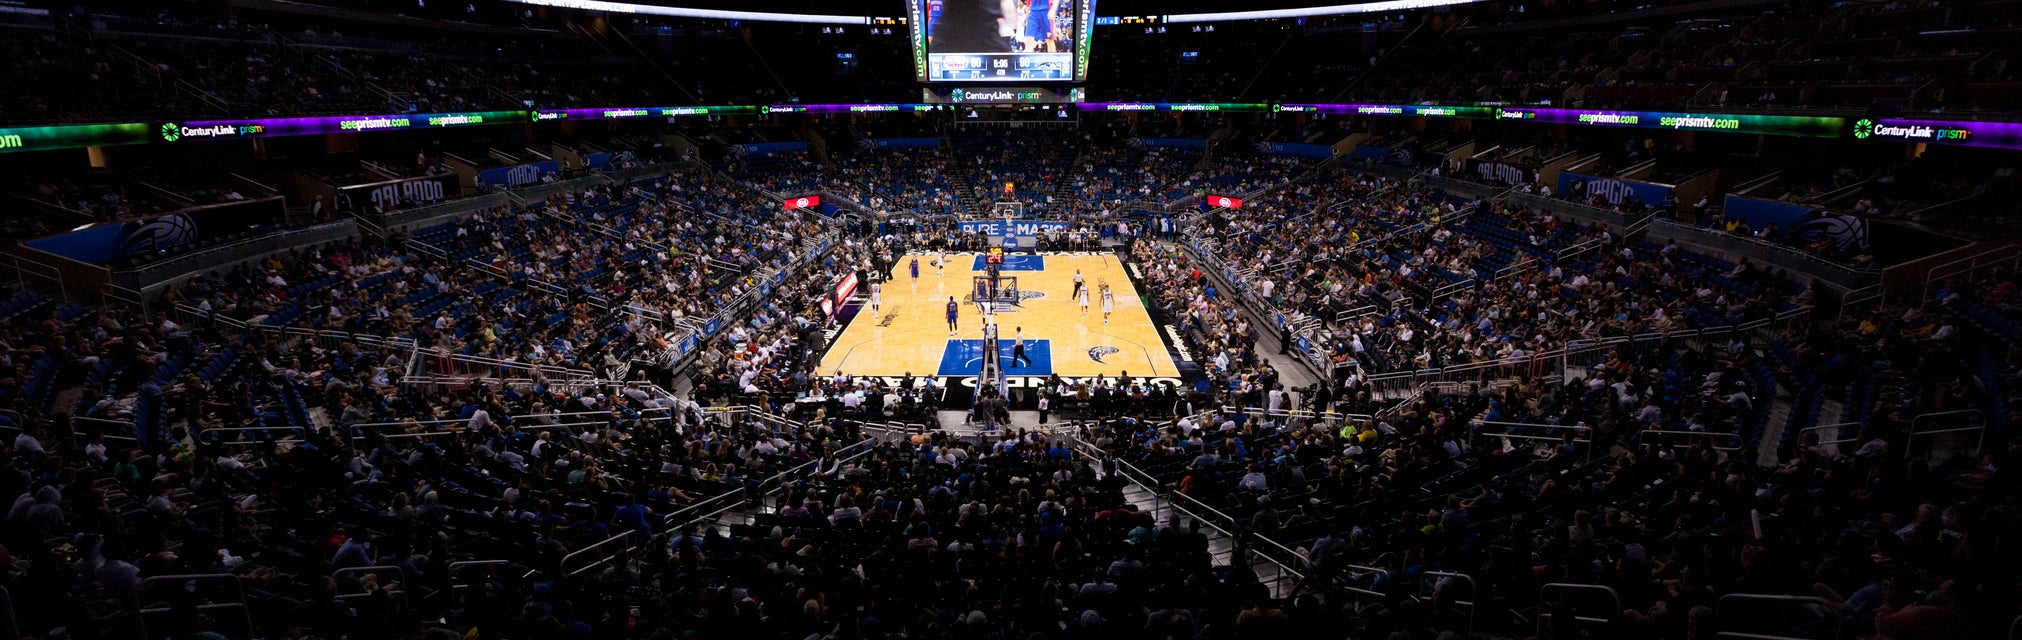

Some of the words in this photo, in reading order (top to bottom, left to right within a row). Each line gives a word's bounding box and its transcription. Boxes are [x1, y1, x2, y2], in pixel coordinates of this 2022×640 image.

[965, 91, 1013, 101] CenturyLink
[1017, 92, 1040, 101] prism
[604, 109, 648, 118] seeprismtv.com
[662, 107, 708, 117] seeprismtv.com
[850, 104, 898, 113] seeprismtv.com
[1107, 103, 1155, 112] seeprismtv.com
[1171, 103, 1219, 112] seeprismtv.com
[1358, 105, 1402, 115] seeprismtv.com
[1416, 106, 1455, 116] seeprismtv.com
[340, 116, 410, 132] seeprismtv.com
[429, 113, 482, 127] seeprismtv.com
[1579, 111, 1638, 125] seeprismtv.com
[1660, 114, 1739, 130] seeprismtv.com
[182, 125, 235, 138] CenturyLink
[240, 124, 262, 136] prism
[1874, 124, 1932, 138] CenturyLink
[1936, 125, 1967, 141] prism
[507, 165, 540, 188] MAGIC
[1477, 161, 1523, 186] ORLANDO
[371, 179, 443, 209] ORLANDO
[1586, 179, 1634, 209] MAGIC
[963, 222, 999, 235] PURE
[1017, 222, 1063, 235] MAGIC
